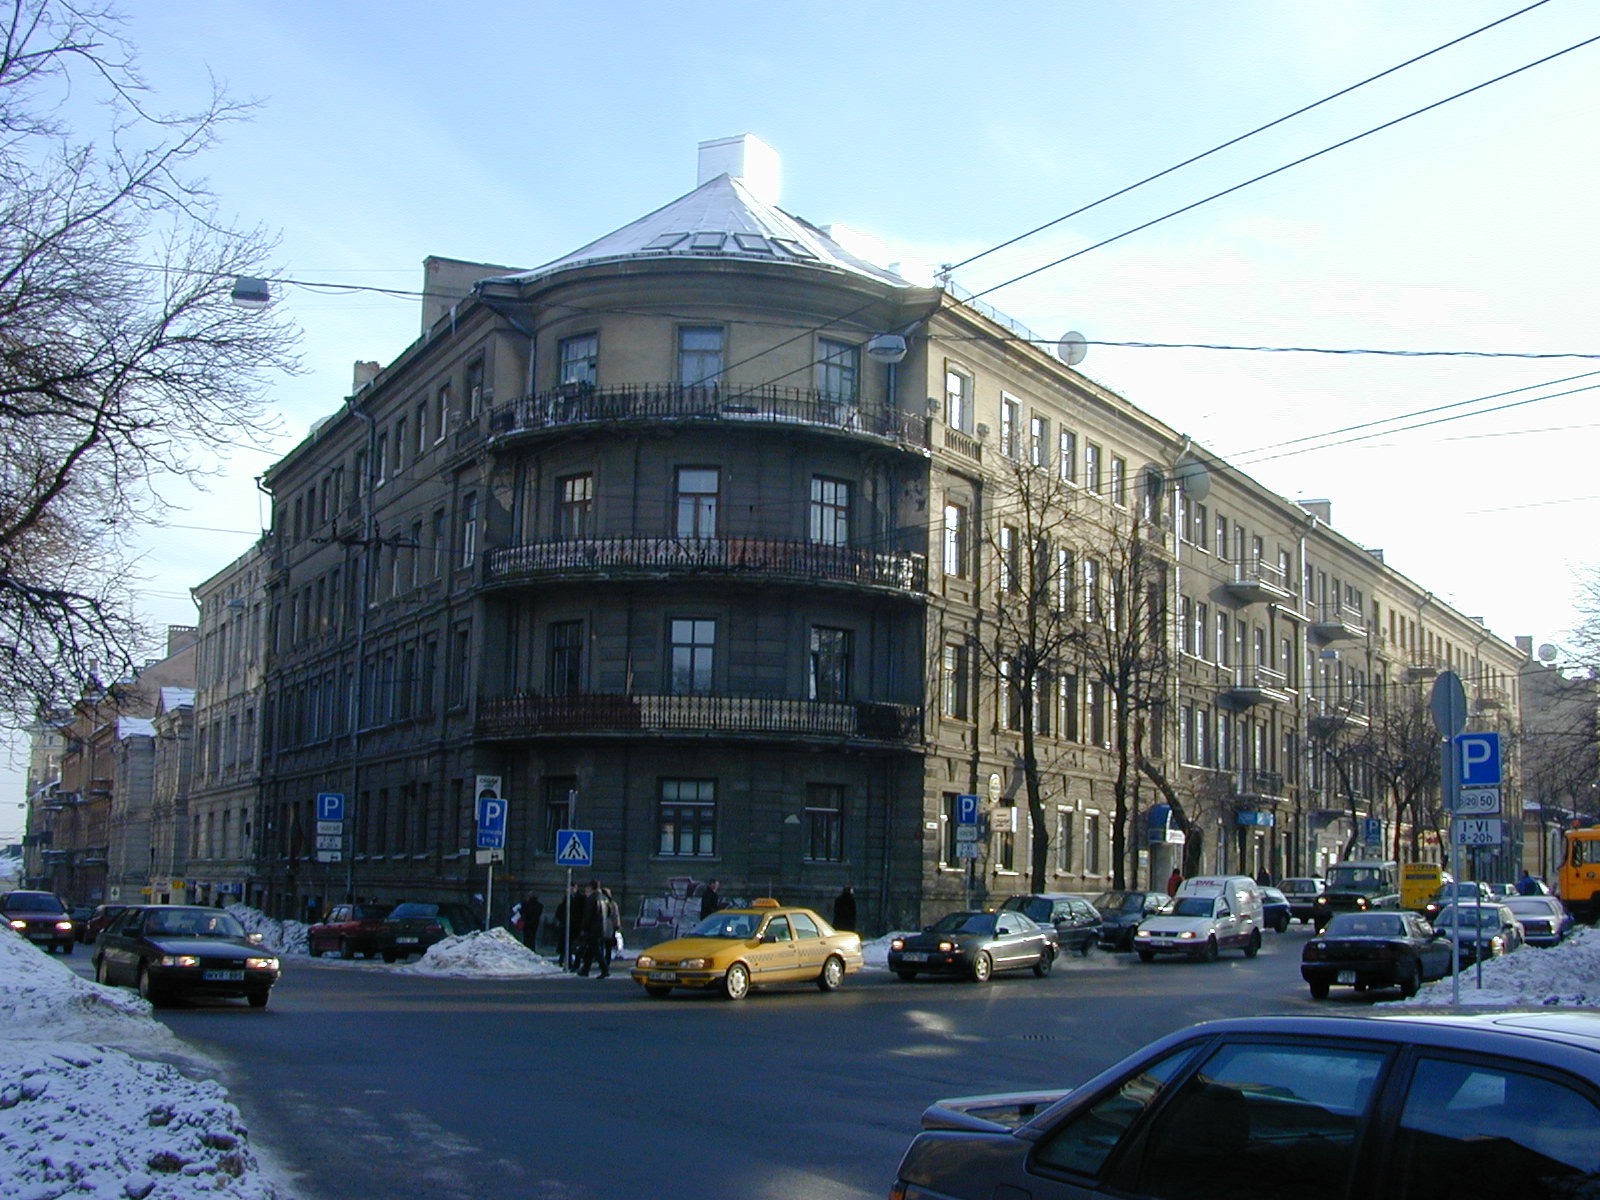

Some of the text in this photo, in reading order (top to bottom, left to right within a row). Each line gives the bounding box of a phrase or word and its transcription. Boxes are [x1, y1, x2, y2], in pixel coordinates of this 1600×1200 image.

[1462, 739, 1492, 780] P
[324, 796, 339, 817] P
[962, 798, 975, 821] P
[1466, 795, 1493, 806] 20 50
[485, 802, 500, 827] P
